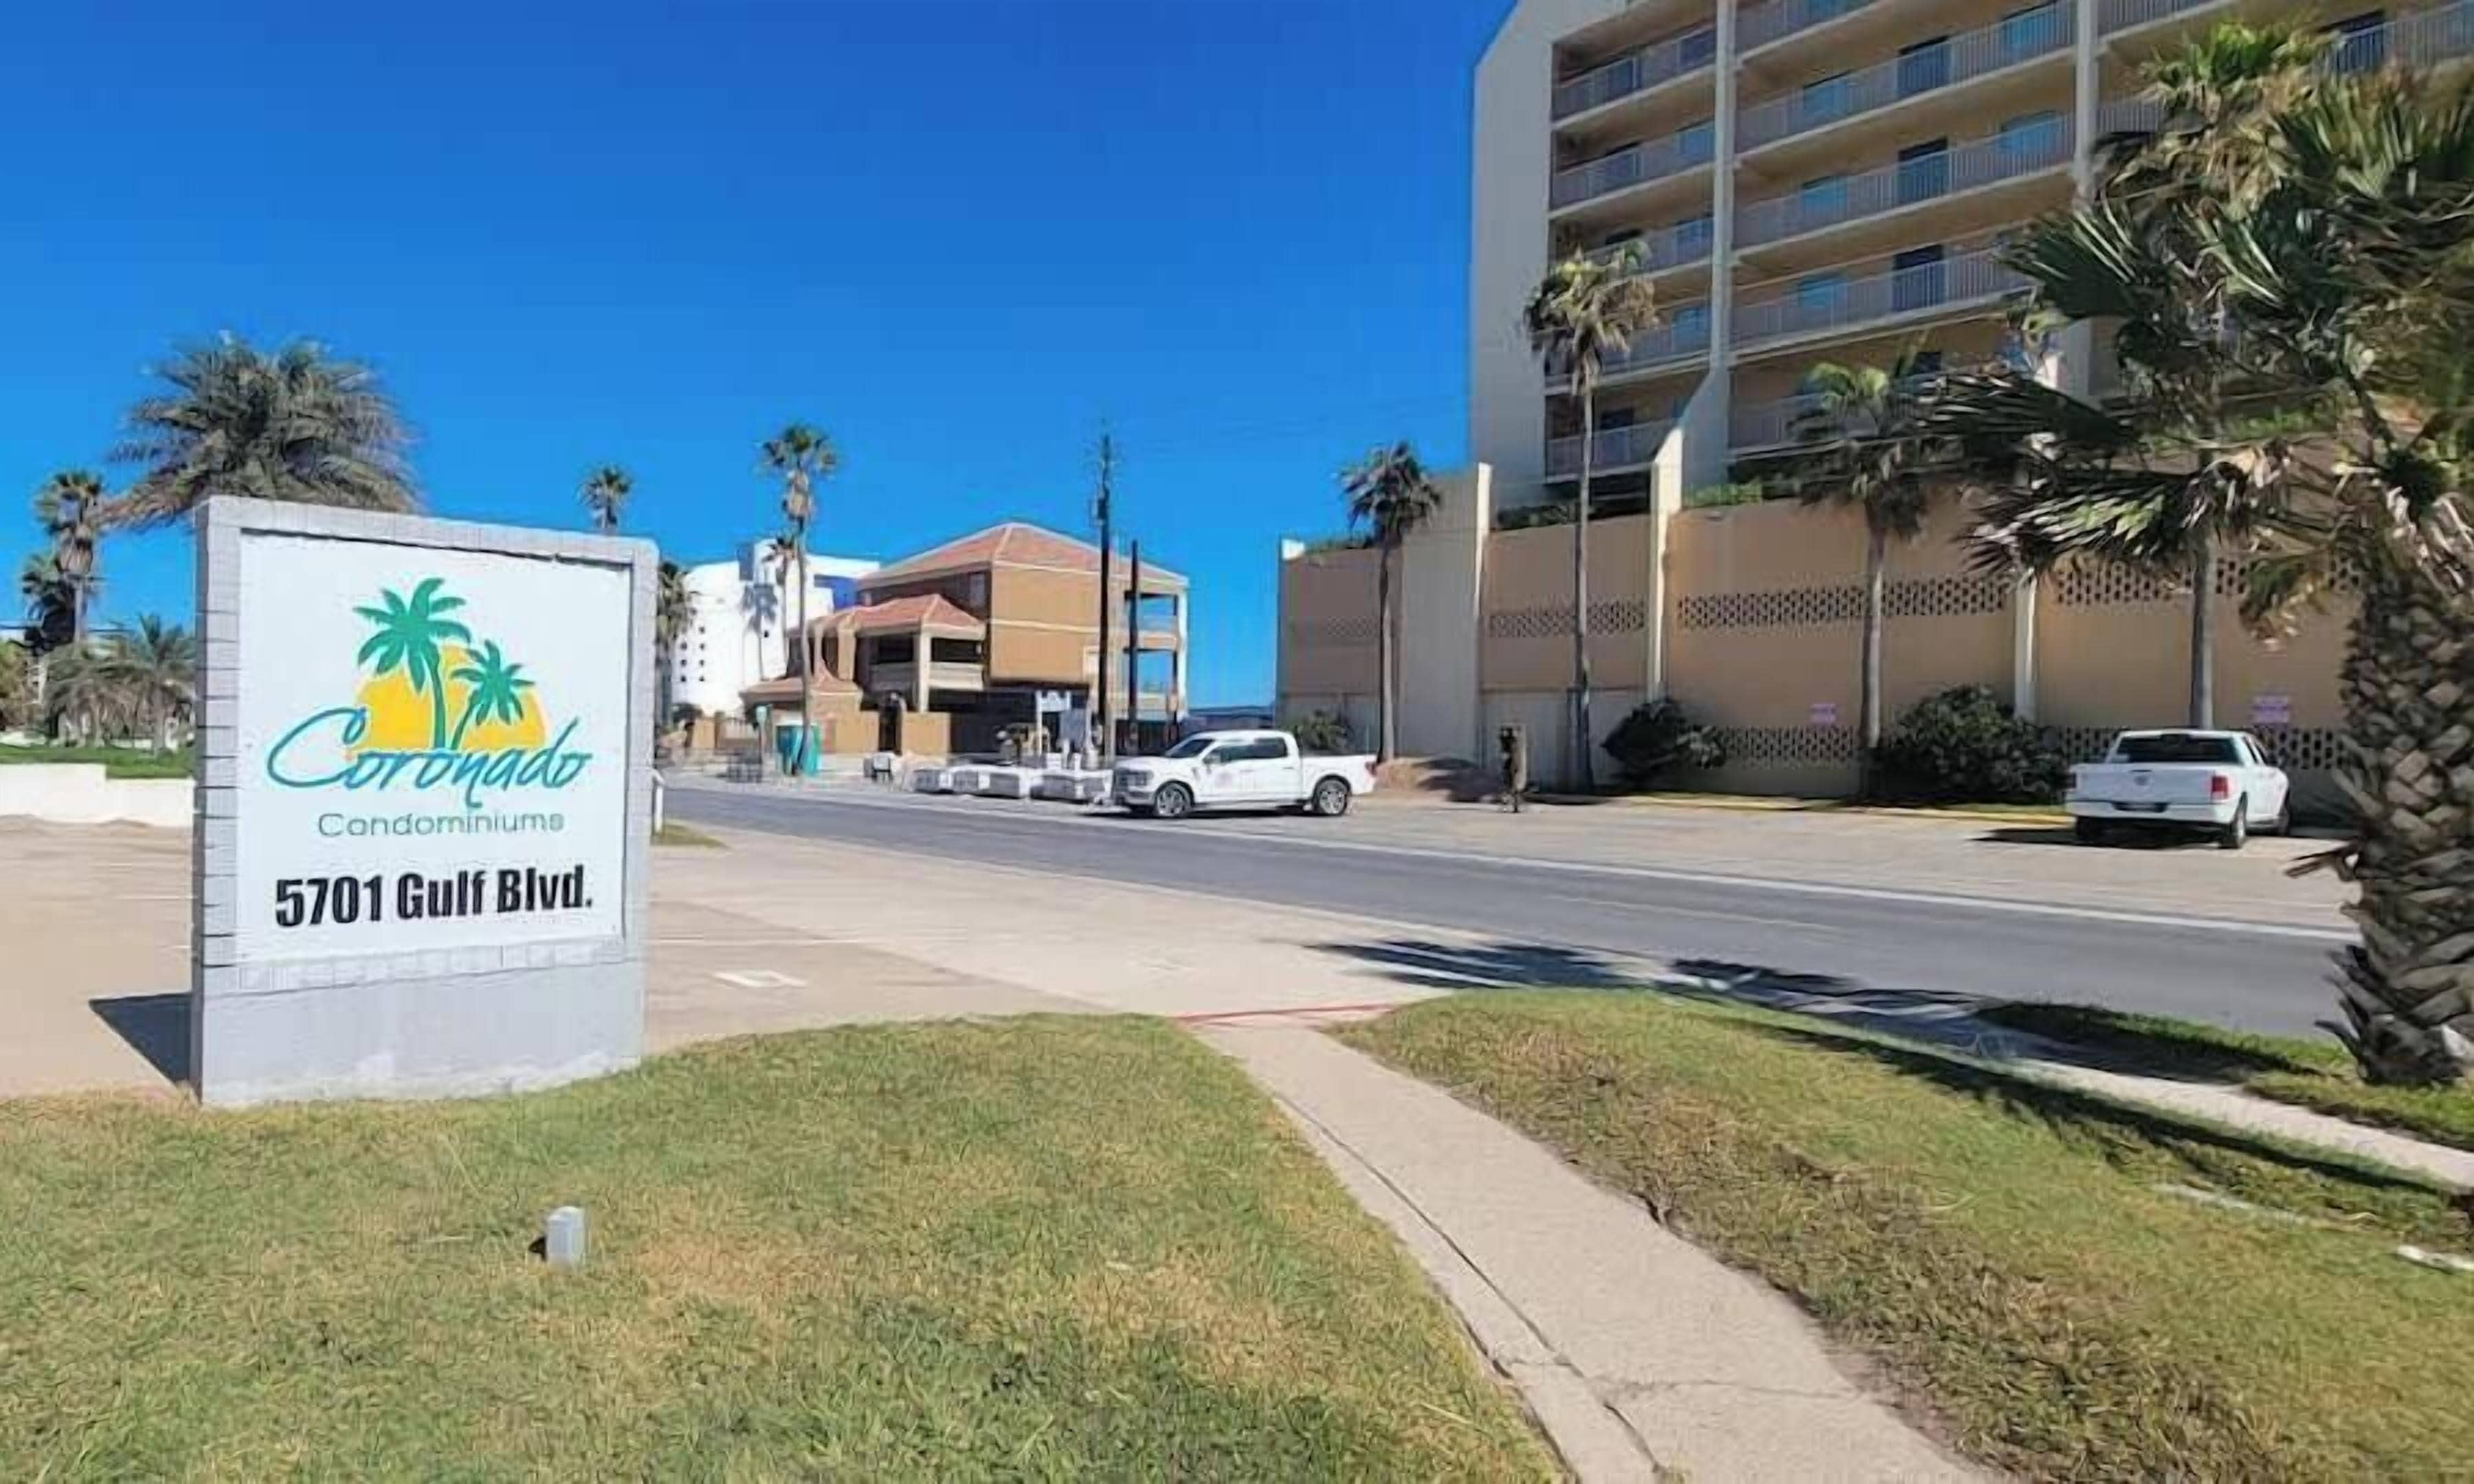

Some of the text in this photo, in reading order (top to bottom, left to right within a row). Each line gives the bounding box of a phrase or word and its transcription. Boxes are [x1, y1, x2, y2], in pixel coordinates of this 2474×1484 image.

[267, 706, 593, 808] Coronado
[317, 812, 565, 837] Condominiums
[275, 864, 593, 928] 5701 Gulf Blvd.
